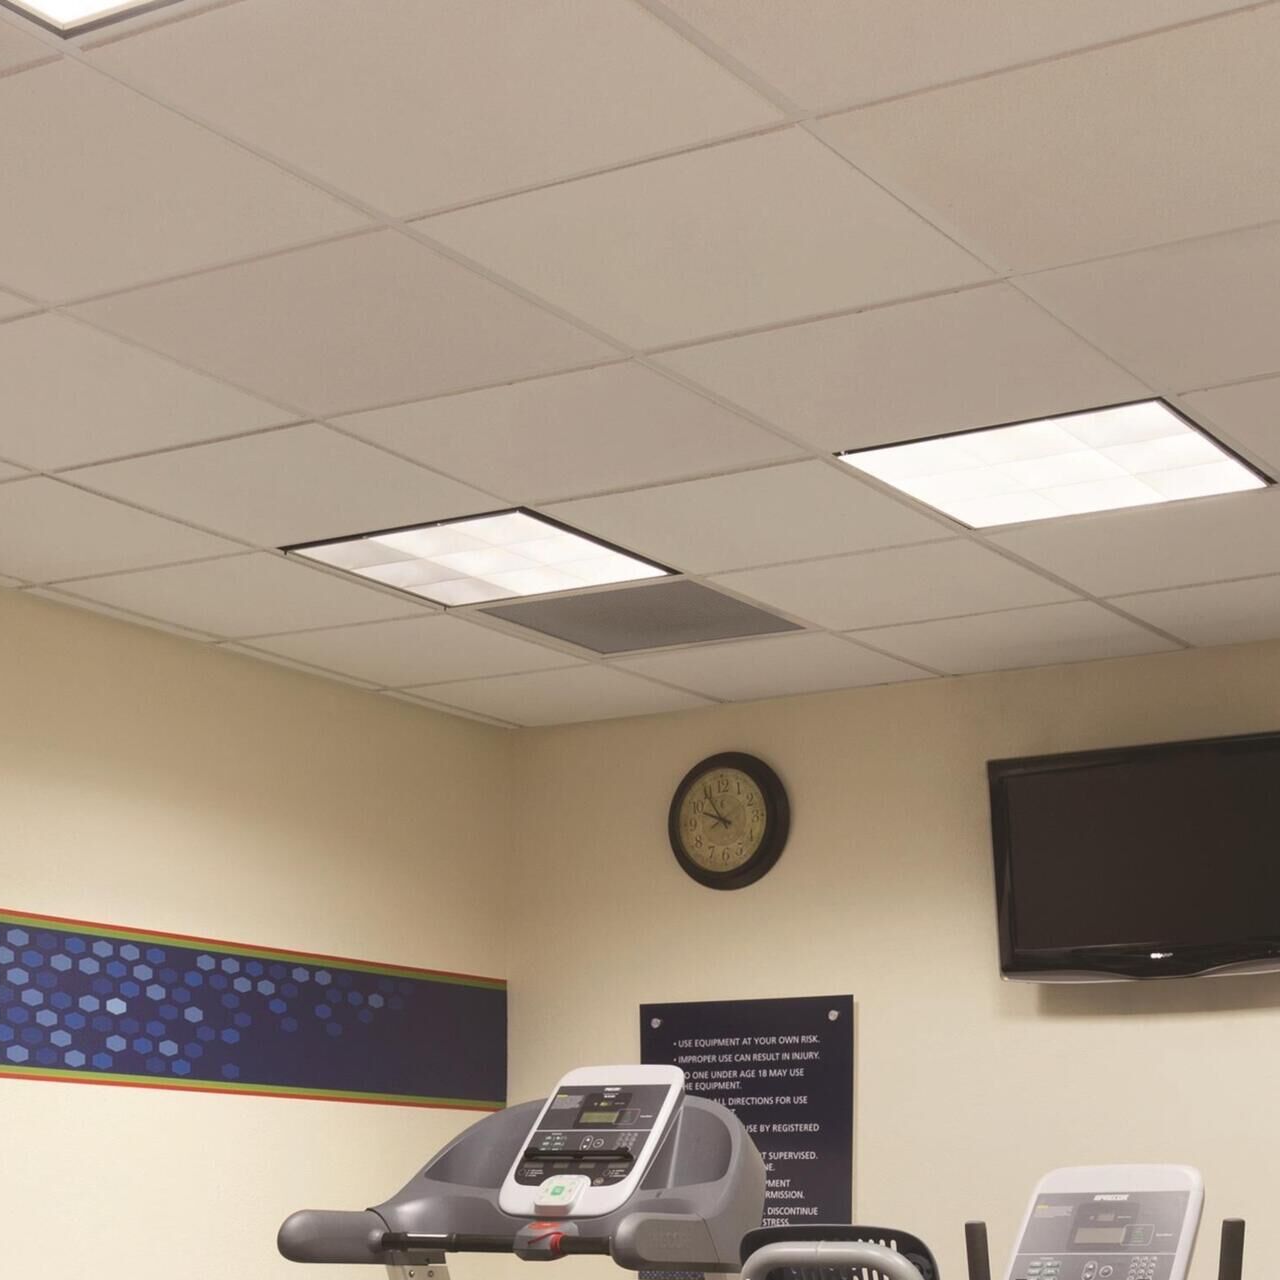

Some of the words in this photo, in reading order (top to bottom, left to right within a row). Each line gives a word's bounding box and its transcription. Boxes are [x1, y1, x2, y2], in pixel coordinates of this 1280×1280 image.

[717, 779, 729, 793] 12
[678, 1039, 692, 1048] USE
[695, 1038, 740, 1047] EQUIPMENT
[742, 1038, 752, 1046] AT
[754, 1037, 776, 1045] YOUR
[779, 1036, 799, 1044] OWN
[801, 1035, 820, 1043] RISK.
[678, 1055, 717, 1064] IMPROPER
[719, 1054, 733, 1062] USE
[734, 1054, 752, 1062] CAN
[753, 1053, 779, 1062] RESULT
[782, 1052, 790, 1060] IN
[791, 1052, 820, 1060] INJURY.
[692, 1071, 709, 1079] ONE
[711, 1070, 737, 1079] UNDER
[739, 1070, 755, 1078] AGE
[759, 1069, 767, 1077] 18
[769, 1069, 787, 1077] MAY
[790, 1068, 804, 1077] USE
[695, 1082, 742, 1090] EQUIPMENT.
[728, 1097, 773, 1105] DIRECTIONS
[776, 1096, 791, 1104] FOR
[793, 1096, 808, 1104] USE
[760, 1124, 770, 1132] BY
[773, 1123, 819, 1132] REGISTERED
[769, 1151, 818, 1159] SUPERVISED.
[765, 1191, 805, 1199] RMISSION.
[768, 1207, 818, 1215] DISCONTINUE
